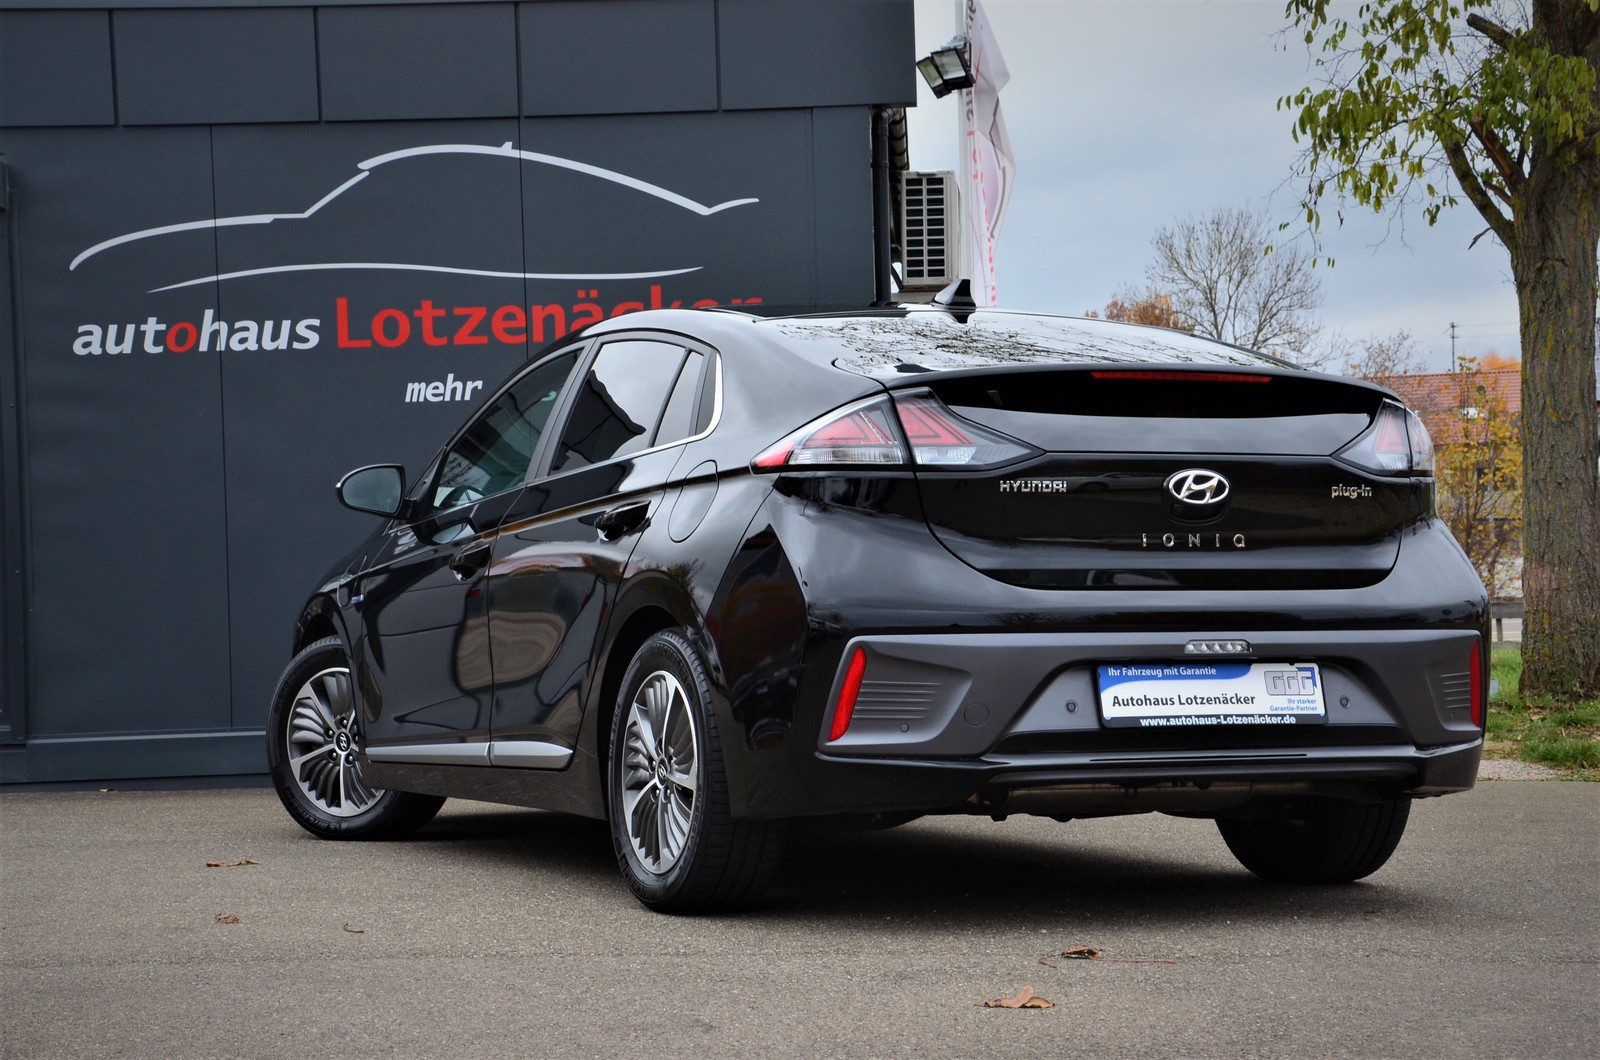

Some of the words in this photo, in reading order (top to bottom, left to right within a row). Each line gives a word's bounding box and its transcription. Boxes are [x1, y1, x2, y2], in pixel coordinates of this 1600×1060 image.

[72, 309, 321, 356] autohaus
[405, 373, 483, 403] mehr
[1000, 480, 1067, 493] HYUNDAI
[1331, 484, 1373, 499] plug-in
[1142, 533, 1246, 548] IONIQ
[1108, 668, 1121, 676] Ihr
[1122, 667, 1162, 677] Fahrzeug
[1163, 667, 1178, 676] mit
[1179, 666, 1217, 676] Garantie
[1112, 695, 1175, 707] Autohaus
[1178, 693, 1256, 706] Lotzenäcker
[1140, 714, 1297, 727] www.autohaus-Lotzenäcker.de
